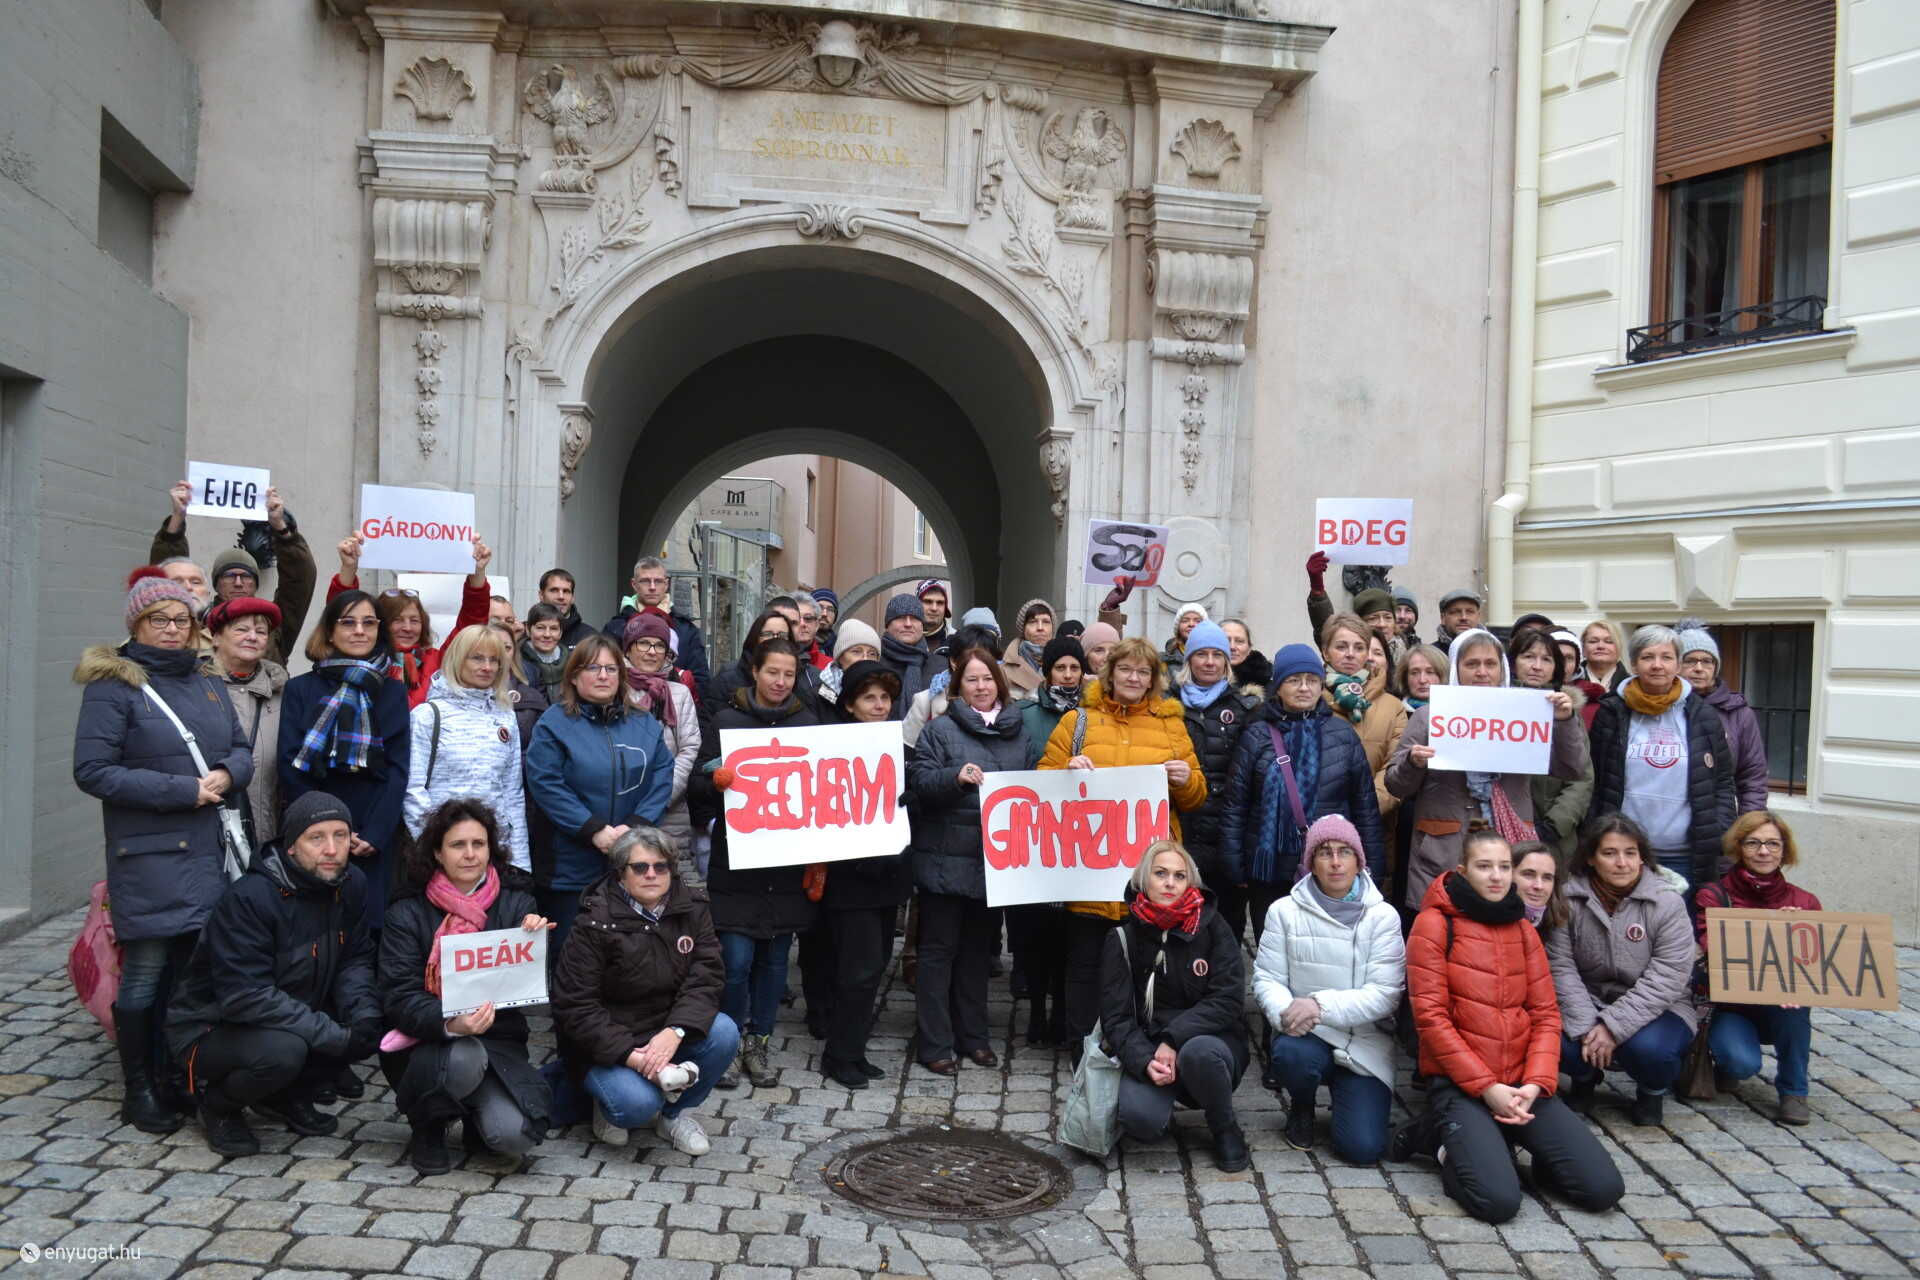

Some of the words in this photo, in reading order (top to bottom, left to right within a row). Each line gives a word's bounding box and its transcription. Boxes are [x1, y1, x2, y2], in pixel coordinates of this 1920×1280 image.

[793, 109, 897, 137] NEMZET
[751, 137, 911, 169] SOPRONNAK
[203, 478, 257, 510] EJEG
[362, 515, 472, 542] GÁRDONYI
[1318, 519, 1408, 545] BDEG
[1430, 715, 1550, 743] SOPRON
[454, 938, 535, 973] DEÁK
[1719, 919, 1886, 998] HARKA
